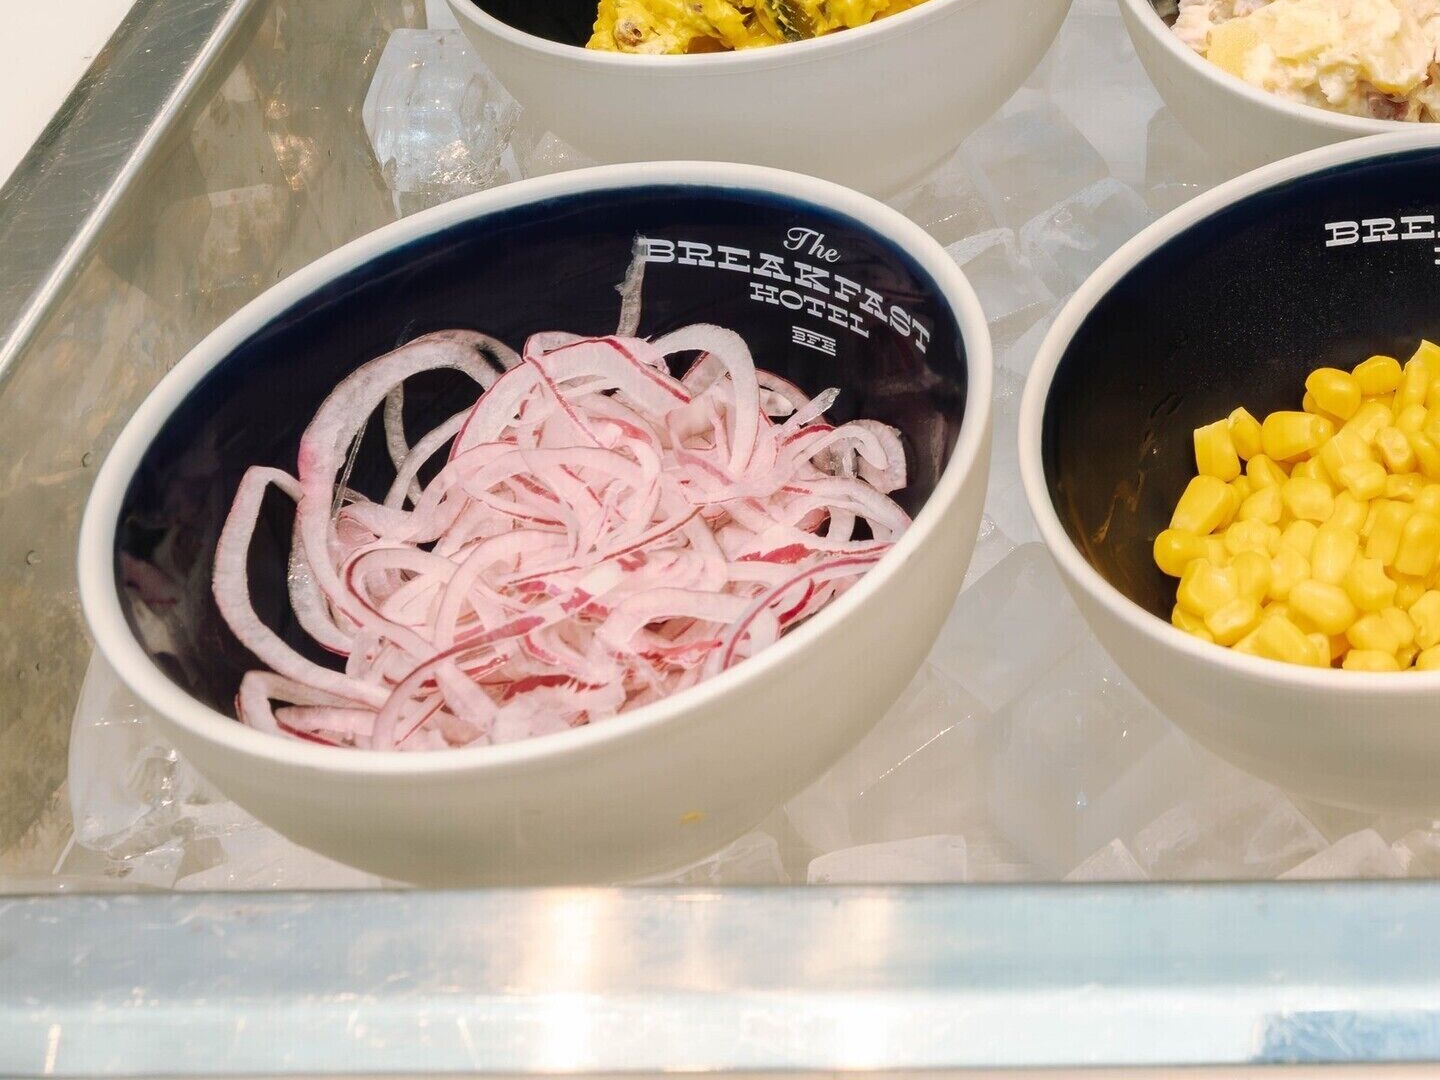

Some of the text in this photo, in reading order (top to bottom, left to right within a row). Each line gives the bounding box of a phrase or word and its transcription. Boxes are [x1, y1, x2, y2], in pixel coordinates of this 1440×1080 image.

[783, 226, 842, 263] The
[638, 238, 931, 354] BREAKFAST
[750, 281, 870, 338] HOTEL
[792, 328, 836, 354] BFH
